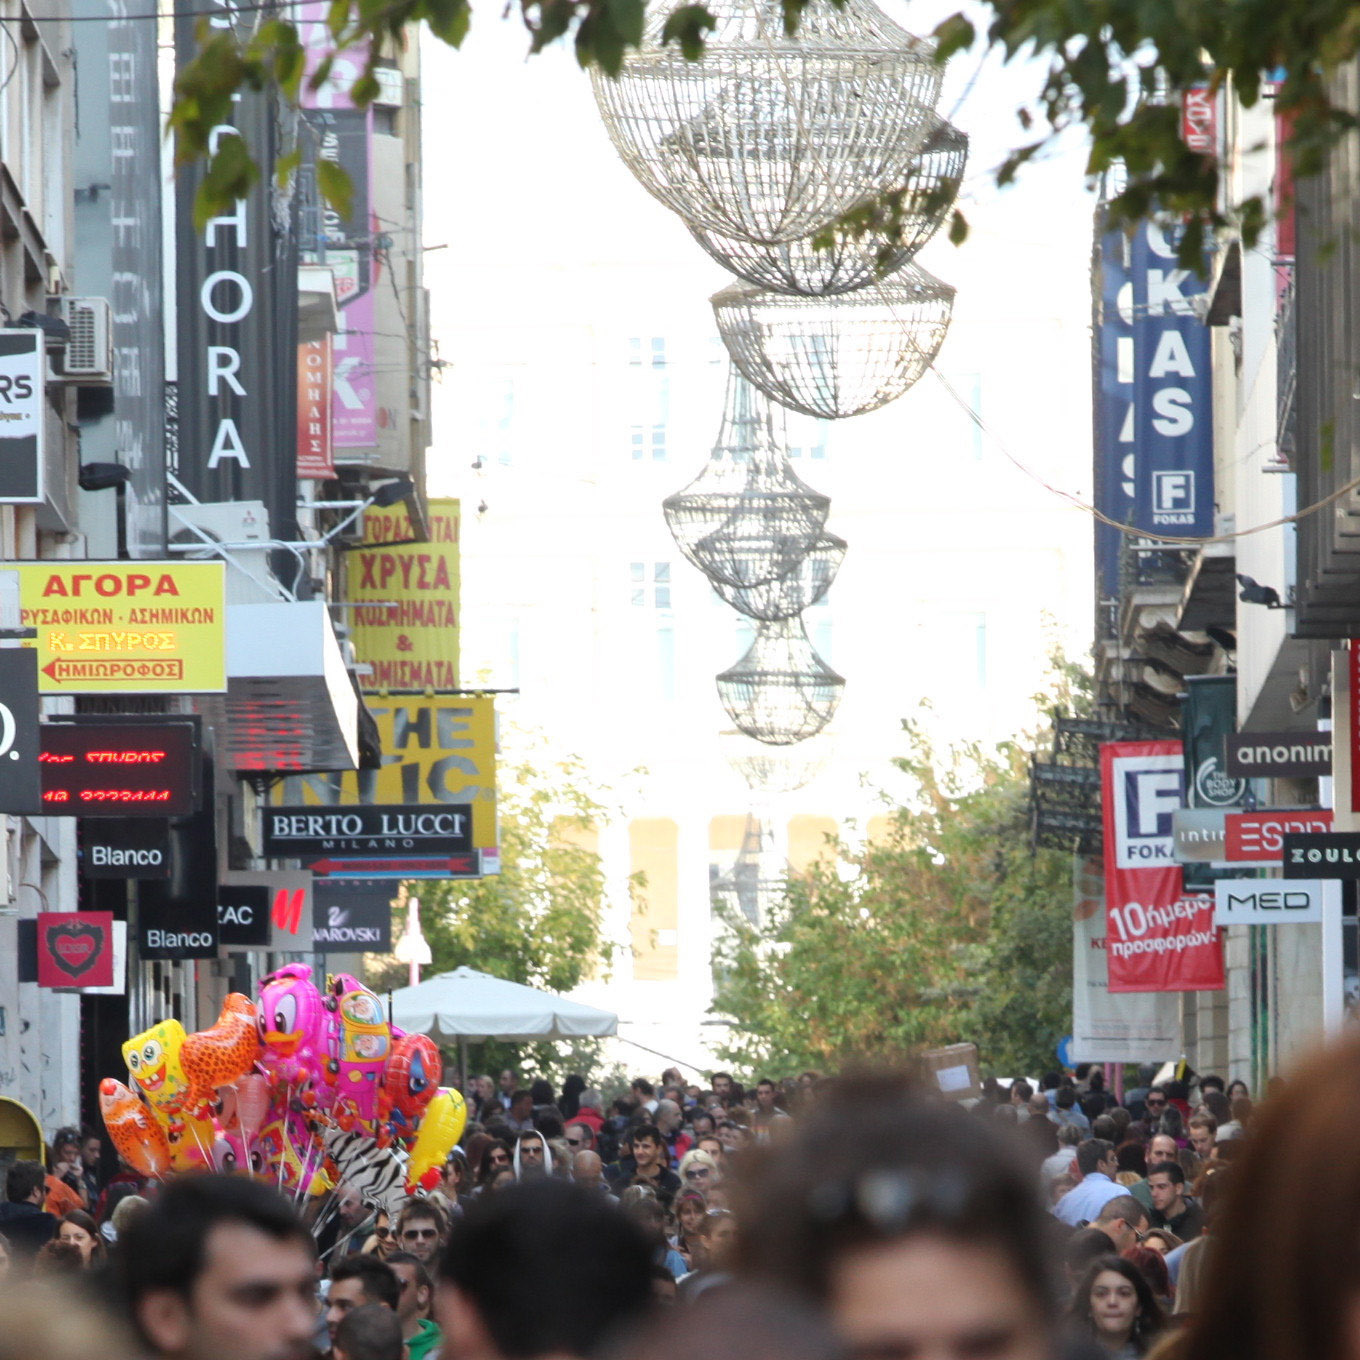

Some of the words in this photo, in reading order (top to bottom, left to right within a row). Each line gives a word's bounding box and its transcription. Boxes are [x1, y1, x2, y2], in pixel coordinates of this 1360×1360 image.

[360, 552, 451, 590] ΧΡΥΣΑ
[42, 573, 180, 598] ΑΓΟΡΑ
[20, 608, 113, 625] ΡΥΣΑΦΙΚΩΝ
[128, 607, 214, 624] ΑΣΗΜΙΚΩΝ
[79, 631, 176, 651] ΣΠΥΡΟΣ
[396, 634, 414, 651] &
[58, 662, 178, 678] ΗΜΙΩΡΟΦΟΣ
[273, 815, 362, 836] BERTO
[381, 814, 462, 836] LUCCI
[322, 839, 415, 849] MILANO
[91, 846, 163, 866] Blanco
[1227, 892, 1311, 911] MED
[147, 929, 213, 947] Blanco
